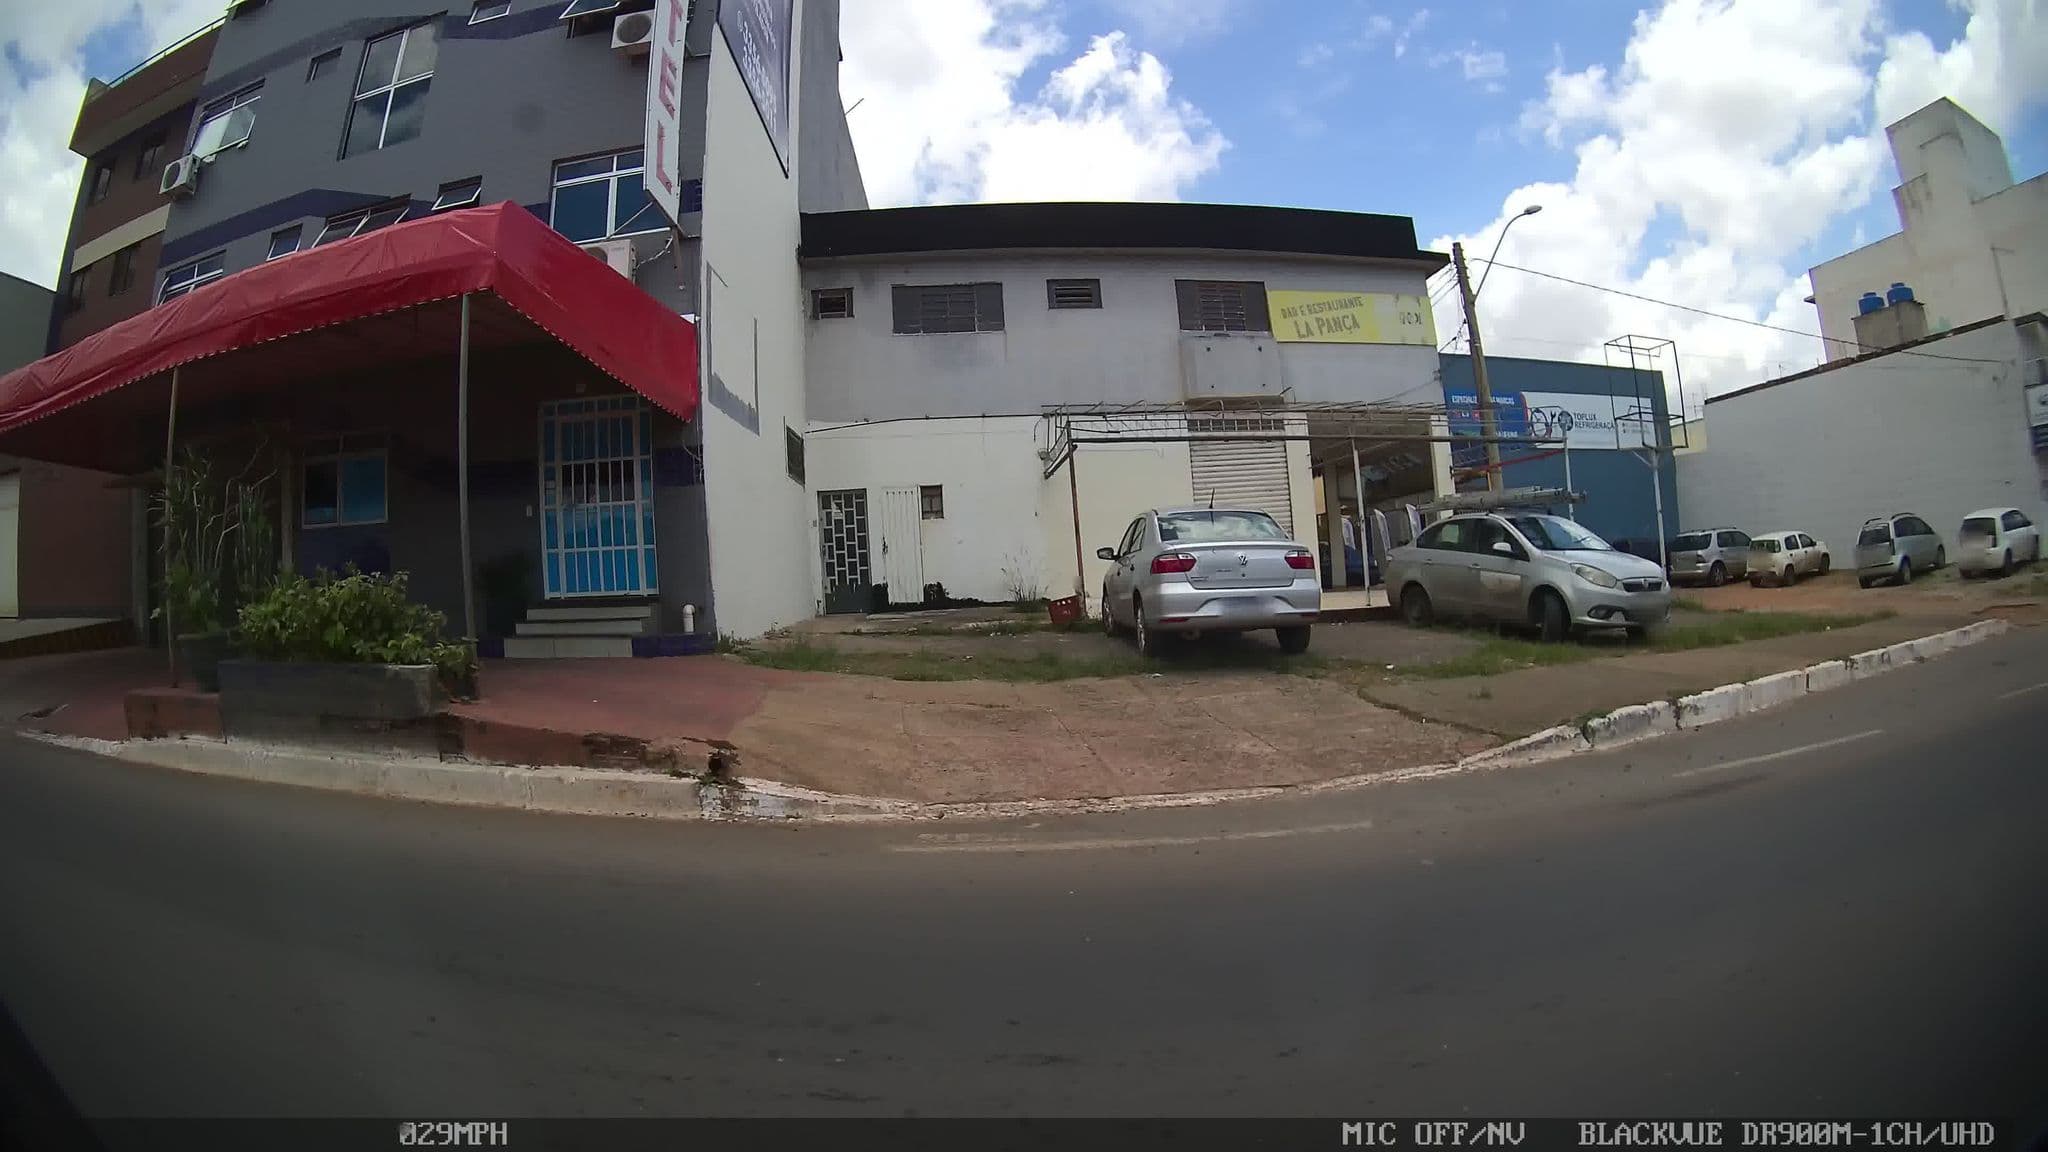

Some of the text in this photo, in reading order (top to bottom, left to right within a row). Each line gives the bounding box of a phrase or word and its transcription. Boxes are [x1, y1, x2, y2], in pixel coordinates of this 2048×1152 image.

[1299, 304, 1307, 317] E
[1307, 296, 1364, 315] RESTAURANTE
[1293, 313, 1361, 338] LA PANÇA
